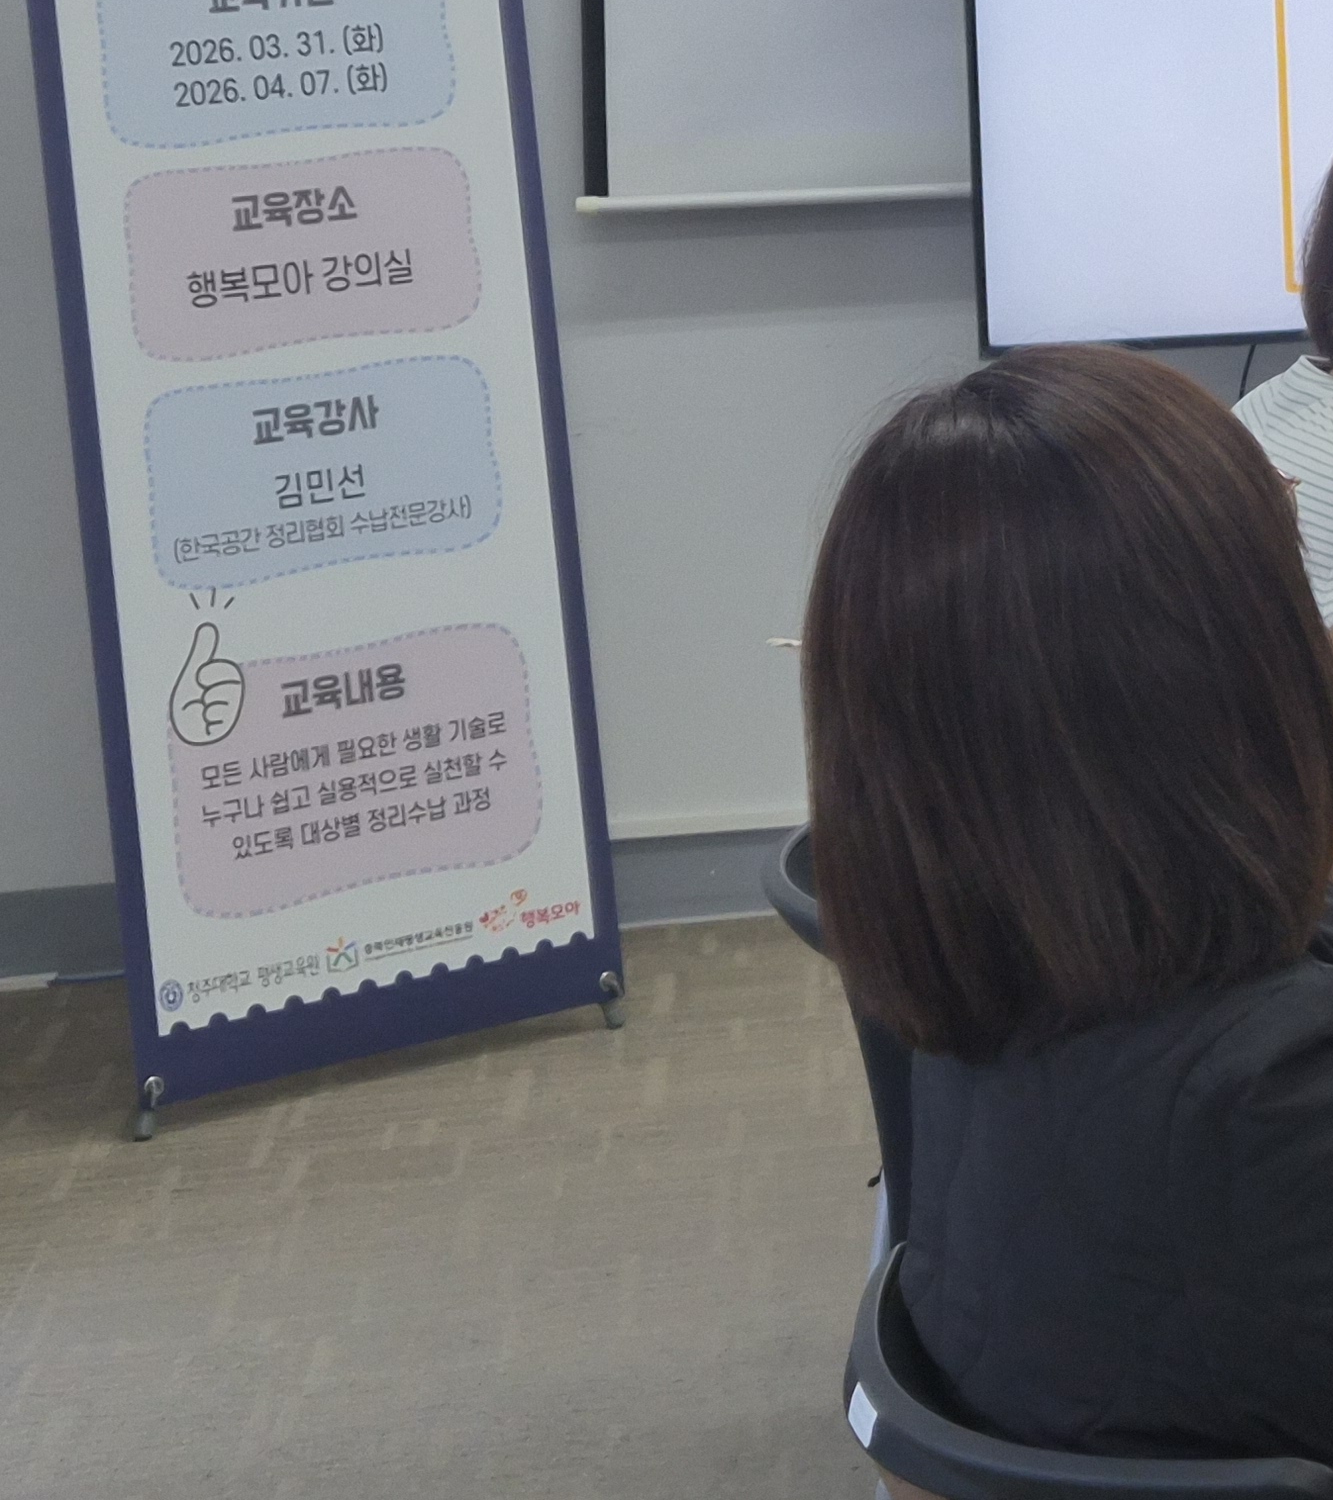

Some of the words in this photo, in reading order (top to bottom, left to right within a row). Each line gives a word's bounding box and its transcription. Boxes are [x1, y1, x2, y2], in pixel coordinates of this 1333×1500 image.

[169, 37, 242, 67] 2026.
[249, 33, 289, 61] 03.
[296, 29, 335, 56] 31.
[342, 22, 384, 56] (화)
[173, 77, 246, 108] 2026.
[253, 73, 293, 100] 04.
[300, 69, 339, 96] 07.
[346, 62, 388, 95] (화)
[231, 185, 358, 232] 교육장소
[186, 259, 314, 309] 행복모아
[322, 248, 414, 293] 강의실
[252, 394, 380, 446] 교육강사
[274, 463, 366, 510] 김민선
[173, 527, 262, 564] (한국공간
[265, 514, 346, 550] 정리협회
[350, 494, 473, 536] 수납전문강사)
[280, 663, 406, 719] 교육내용
[201, 760, 243, 791] 모든
[249, 744, 333, 781] 사람에게
[336, 731, 399, 766] 필요한
[402, 722, 443, 752] 생활
[448, 711, 508, 743] 기술로
[201, 795, 265, 828] 누구나
[269, 785, 312, 816] 쉽고
[316, 765, 419, 807] 실용적으로
[423, 752, 483, 786] 실천할
[488, 749, 508, 772] 수
[231, 825, 295, 861] 있도록
[300, 813, 362, 847] 대상별
[366, 795, 448, 833] 정리수납
[452, 787, 492, 816] 과정
